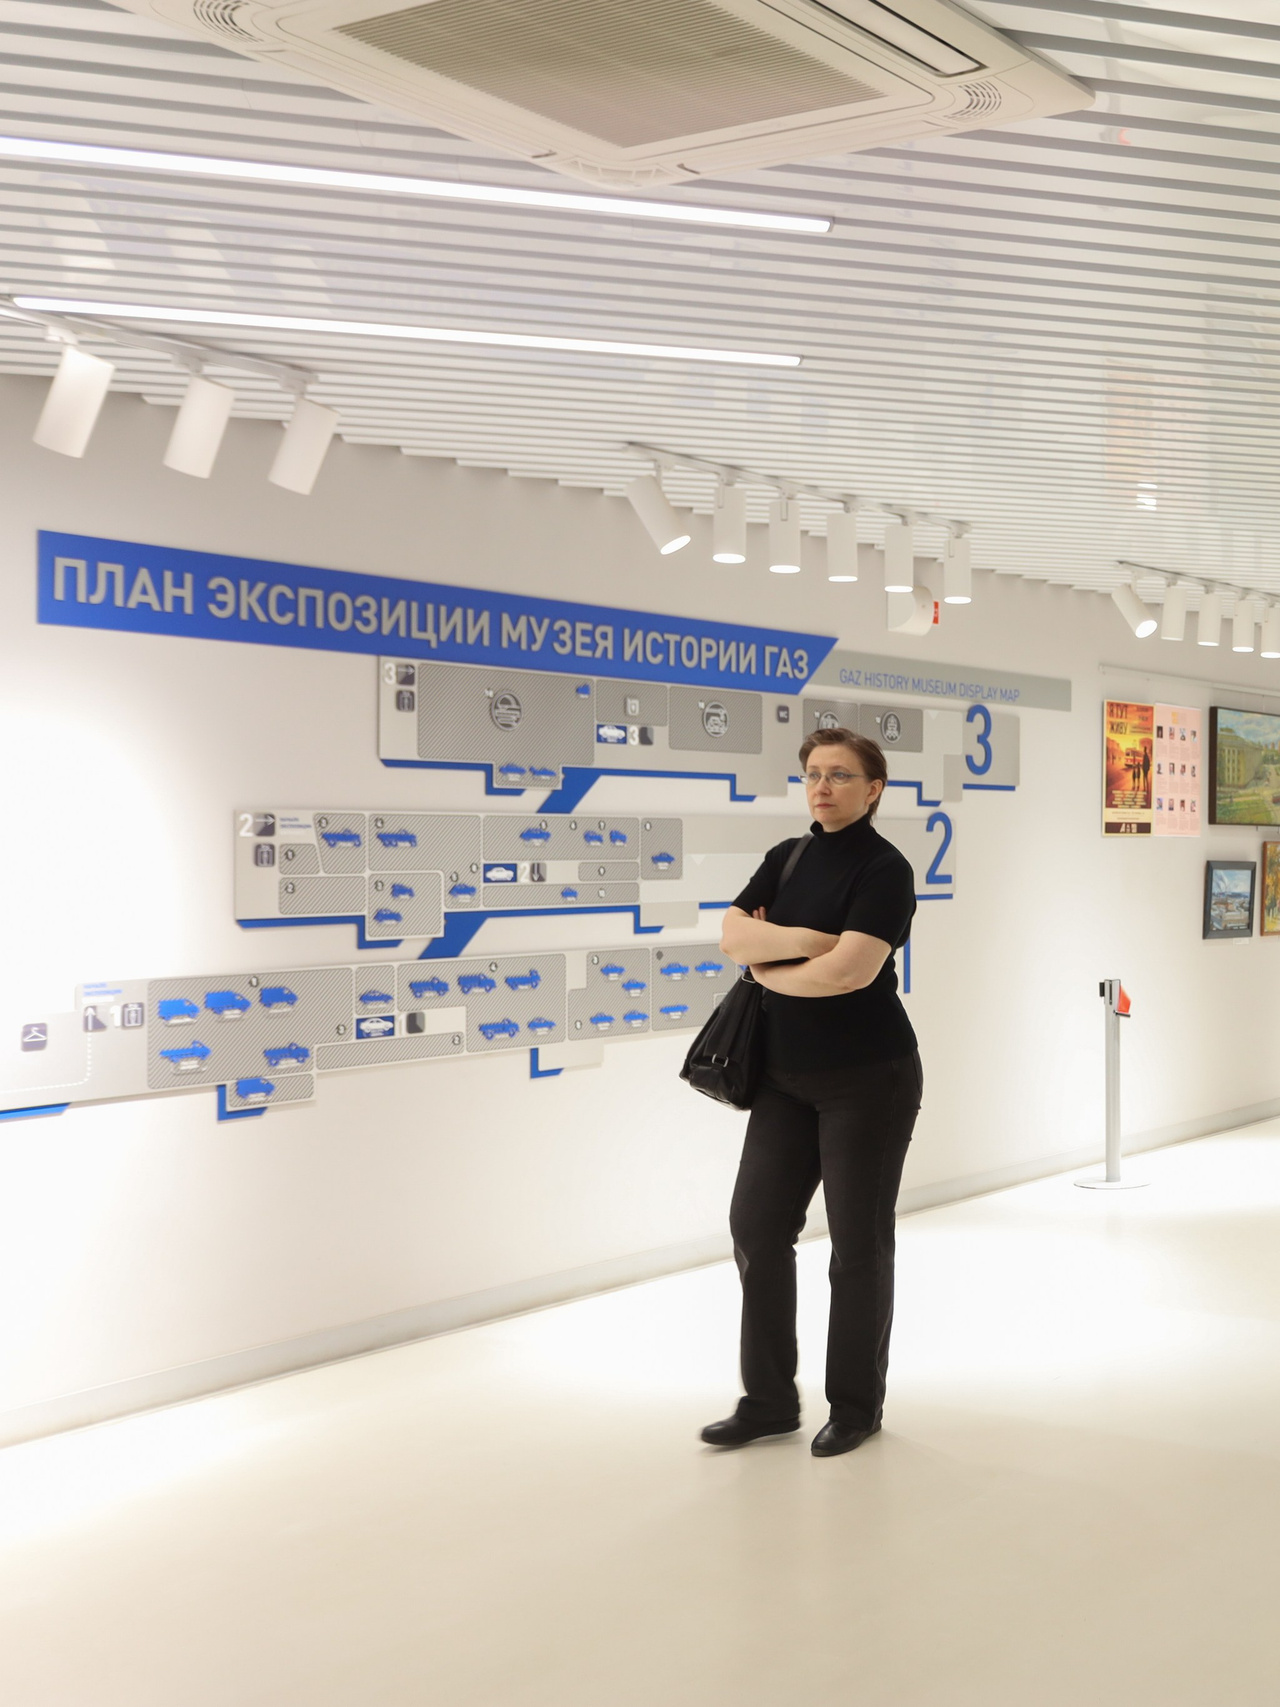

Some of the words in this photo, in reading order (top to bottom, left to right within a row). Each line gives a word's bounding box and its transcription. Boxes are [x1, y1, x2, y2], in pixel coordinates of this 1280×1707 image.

[54, 556, 194, 615] ПЛАН
[207, 576, 491, 649] ЭКСПОЗИЦИИ
[501, 612, 614, 660] МУЗЕЯ
[623, 627, 757, 676] ИСТОРИИ
[764, 645, 810, 680] ГАЗ
[384, 662, 397, 685] 3
[839, 668, 861, 687] GAZ
[864, 672, 910, 691] HISTORY
[911, 677, 957, 697] MUSEUM
[959, 682, 999, 701] DISPLAY
[999, 688, 1021, 703] MAP
[629, 725, 639, 746] 3
[965, 704, 992, 776] 3
[239, 813, 254, 837] 2
[925, 811, 953, 885] 2
[520, 862, 530, 883] 2
